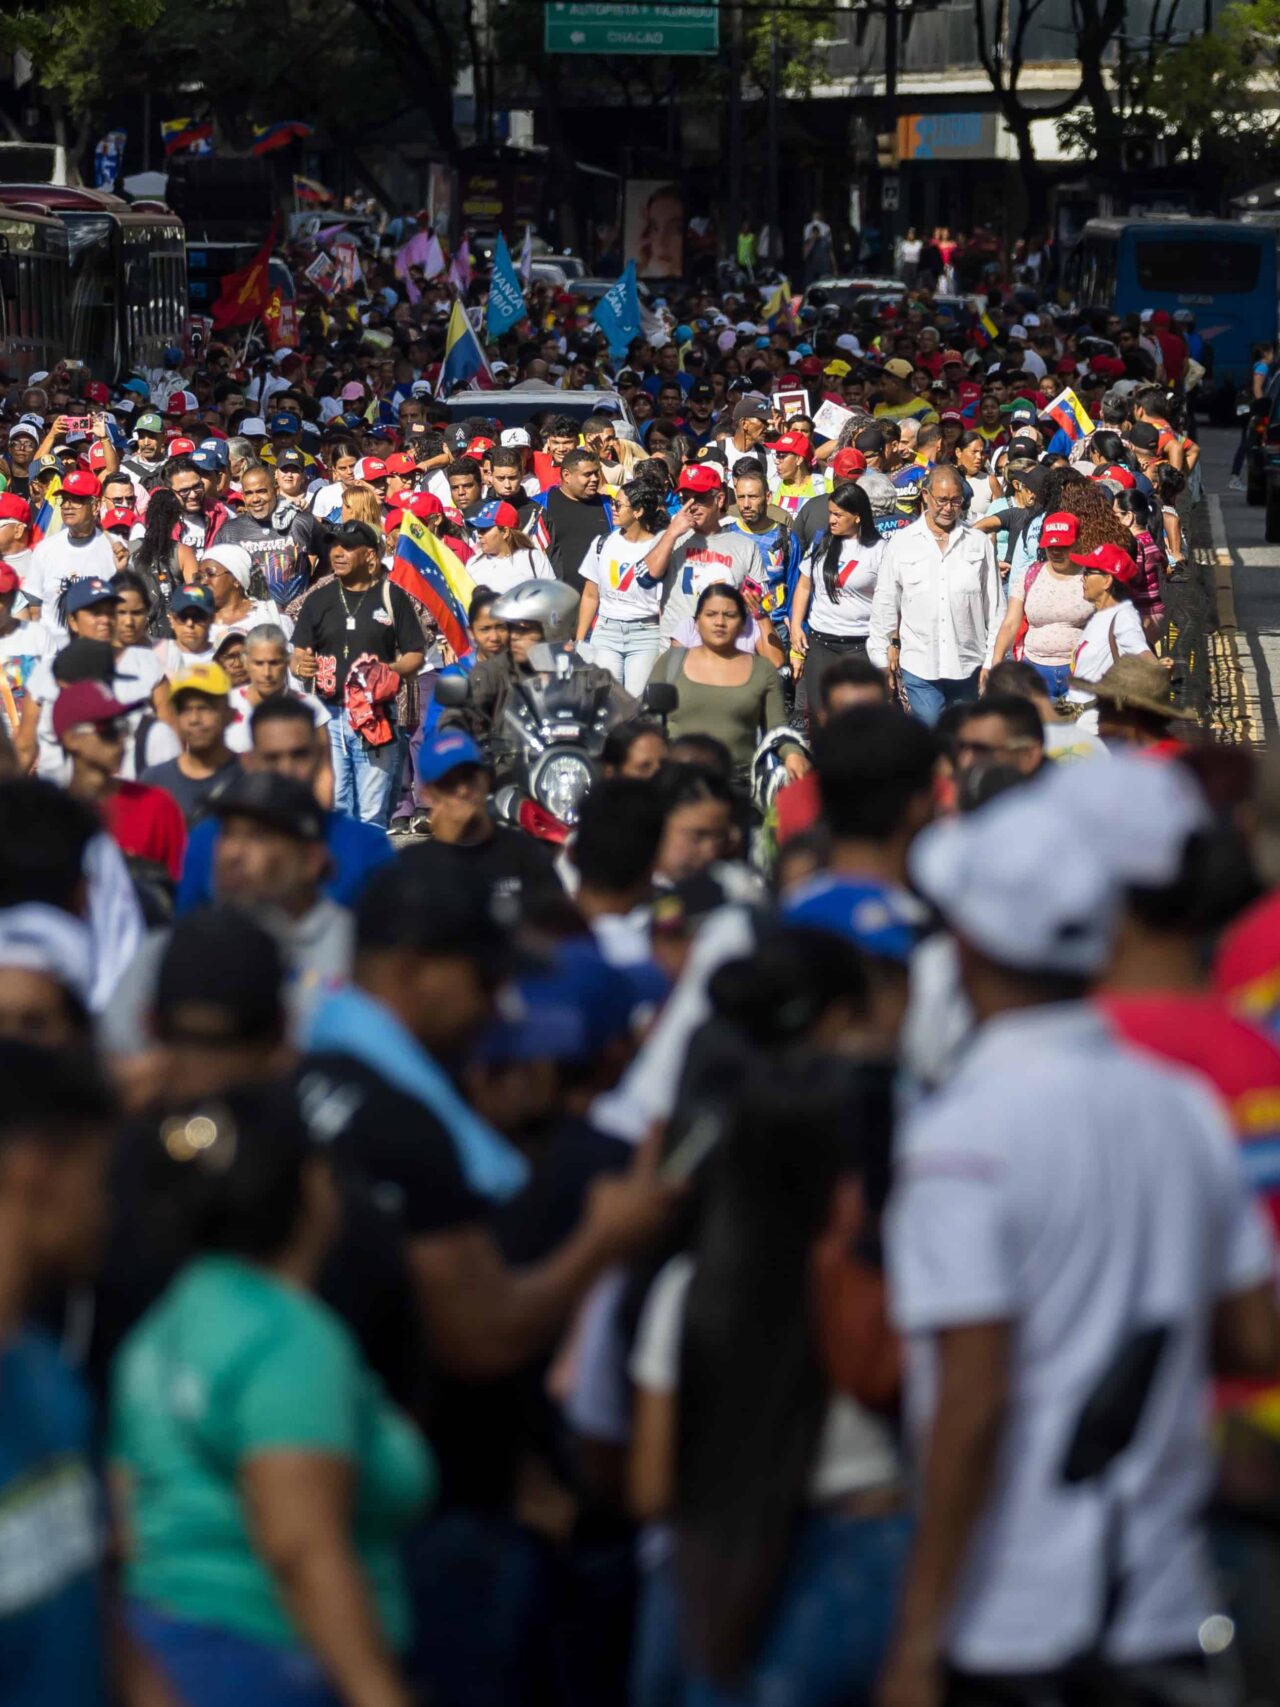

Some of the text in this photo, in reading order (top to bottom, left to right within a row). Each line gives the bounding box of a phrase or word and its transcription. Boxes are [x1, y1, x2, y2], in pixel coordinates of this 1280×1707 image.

[607, 31, 663, 44] CHACAO
[1045, 523, 1069, 532] SALUD
[239, 535, 295, 554] VENEZUELA
